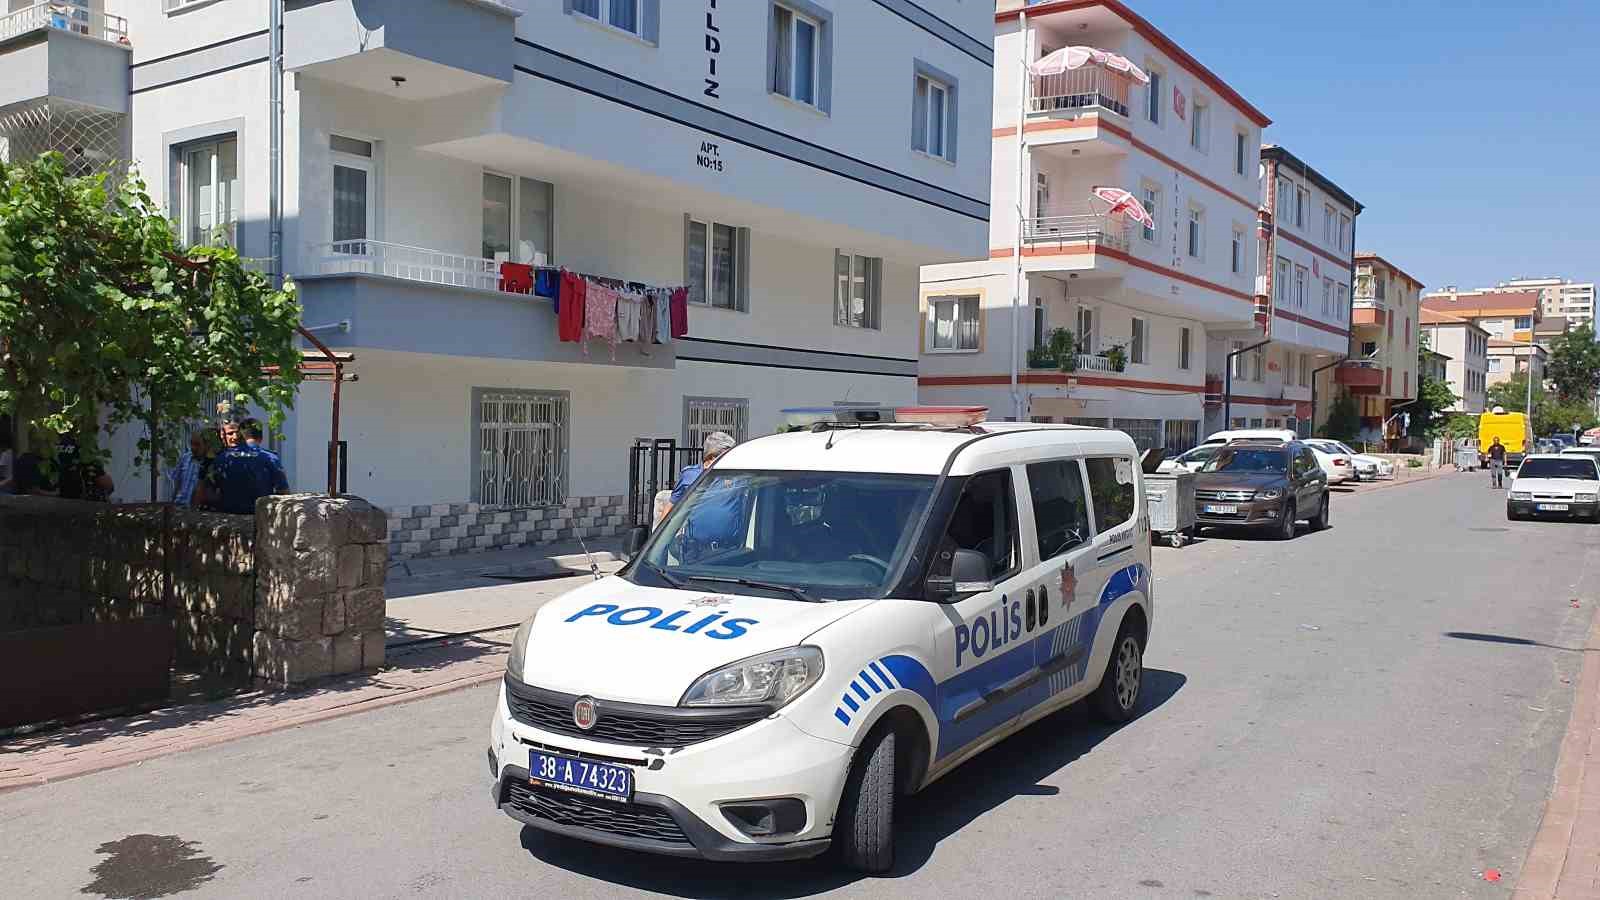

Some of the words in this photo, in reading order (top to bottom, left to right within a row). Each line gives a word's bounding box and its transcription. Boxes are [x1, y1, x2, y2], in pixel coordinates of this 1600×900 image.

[696, 155, 723, 172] NO:15
[700, 141, 720, 157] APT.
[564, 604, 760, 639] POLİS
[955, 593, 1022, 668] POLİS
[539, 755, 556, 779] 38
[564, 761, 573, 783] A
[580, 762, 626, 793] 74323
